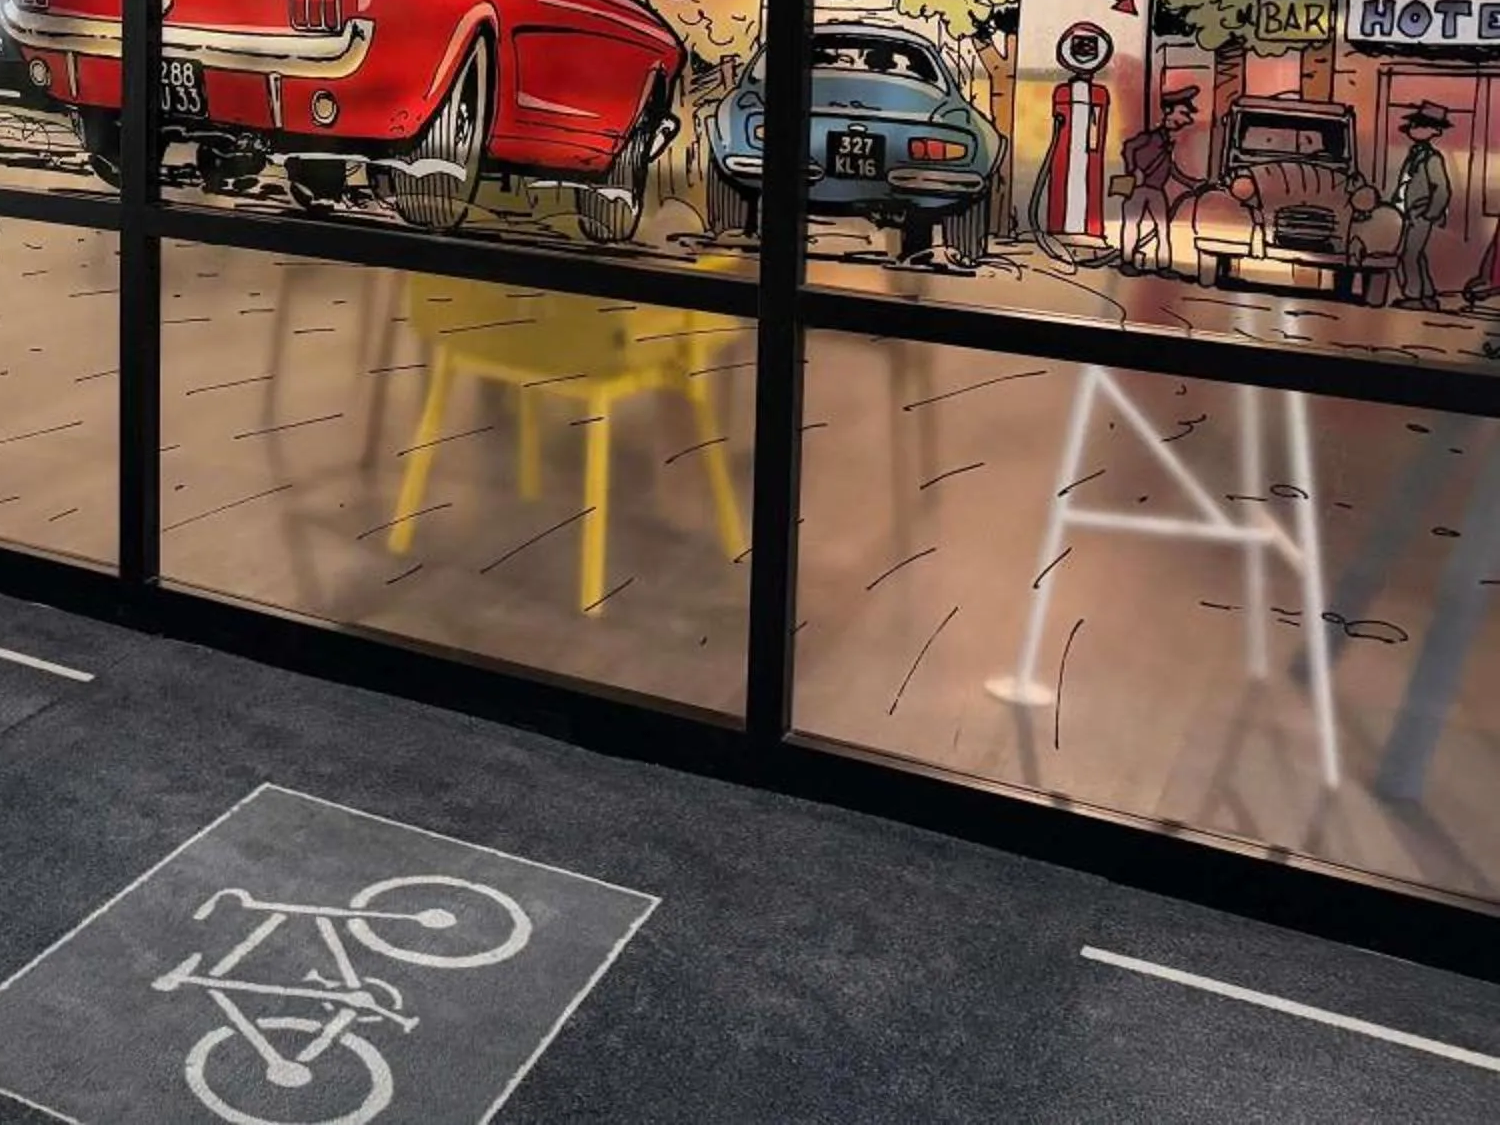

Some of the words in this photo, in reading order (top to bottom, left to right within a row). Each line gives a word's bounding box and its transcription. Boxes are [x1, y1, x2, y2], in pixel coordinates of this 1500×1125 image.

[1263, 3, 1328, 35] BAR
[175, 87, 201, 113] 33
[839, 136, 873, 155] 327
[835, 155, 855, 174] KL
[858, 158, 876, 176] 16
